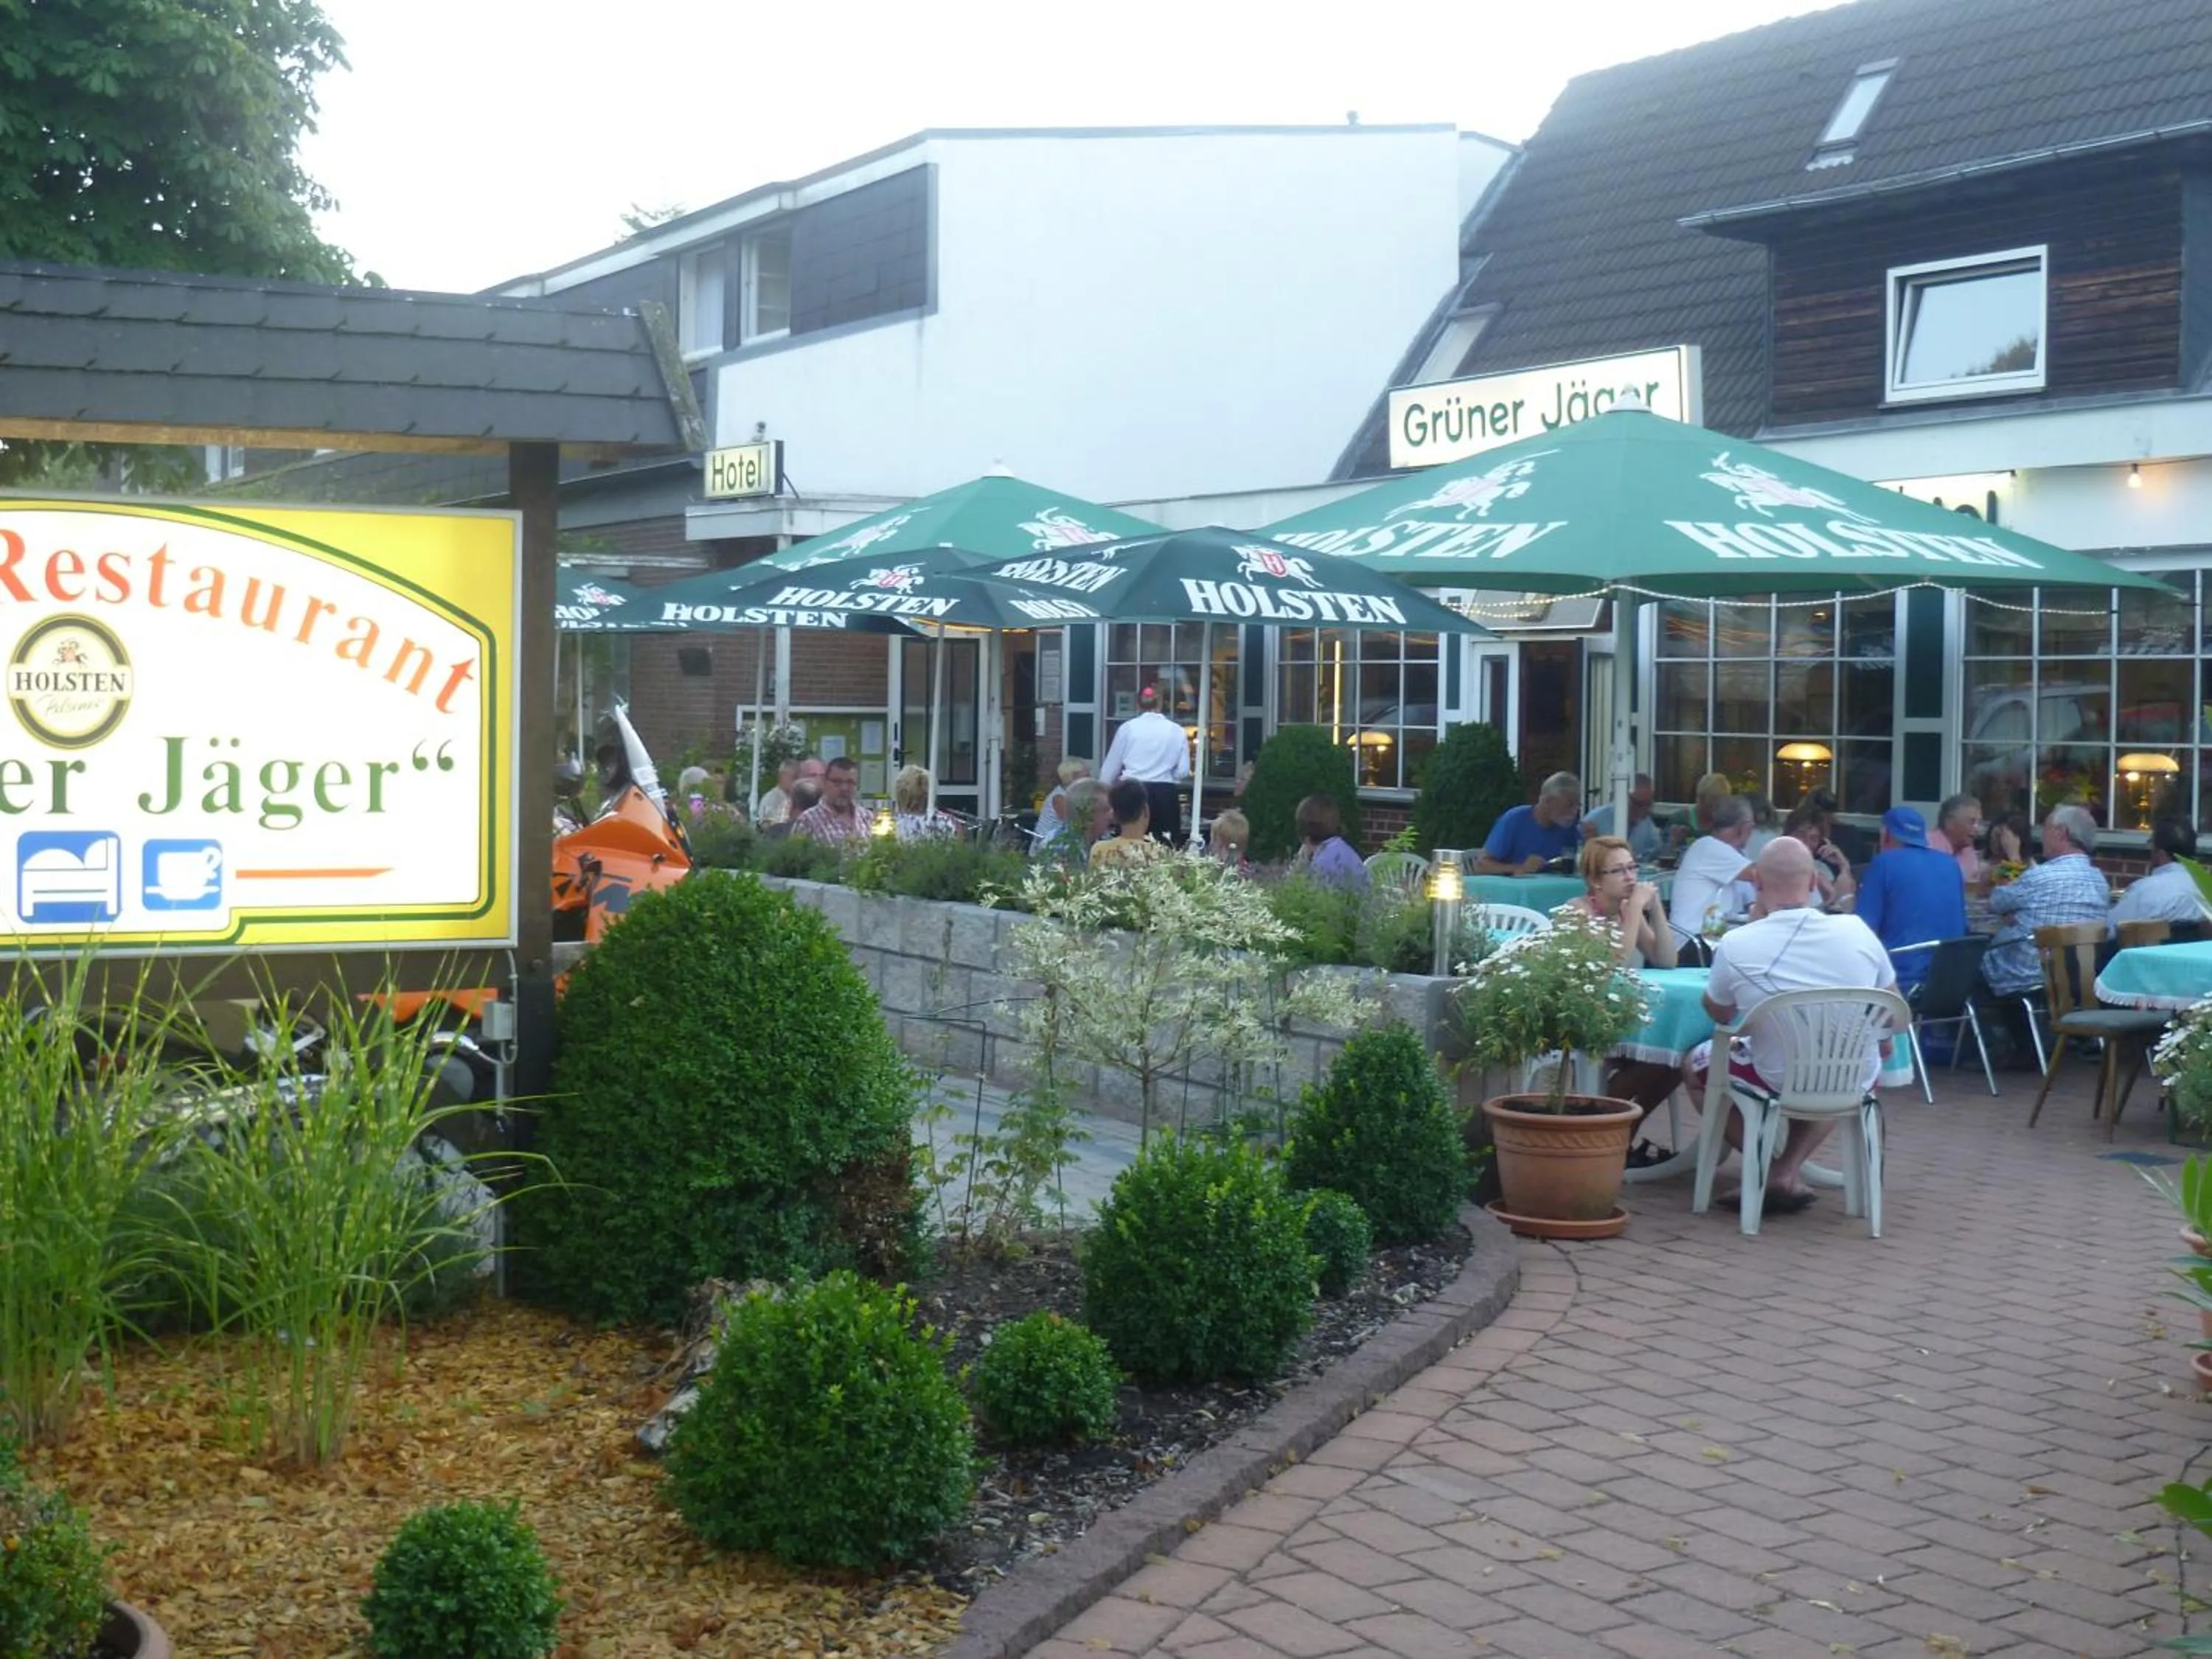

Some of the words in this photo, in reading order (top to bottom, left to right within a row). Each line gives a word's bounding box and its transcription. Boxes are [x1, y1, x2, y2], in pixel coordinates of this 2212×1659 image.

[1404, 397, 1526, 448] Grüner
[1541, 379, 1660, 431] Jär
[712, 449, 762, 492] Hotel
[1664, 519, 2045, 569] HOLSTEN
[0, 529, 476, 714] Restaurant
[661, 602, 849, 629] HOLSTEN
[766, 585, 959, 617] HOLSTEN
[1180, 577, 1408, 625] HOLSTEN
[15, 671, 125, 693] HOLSTEN
